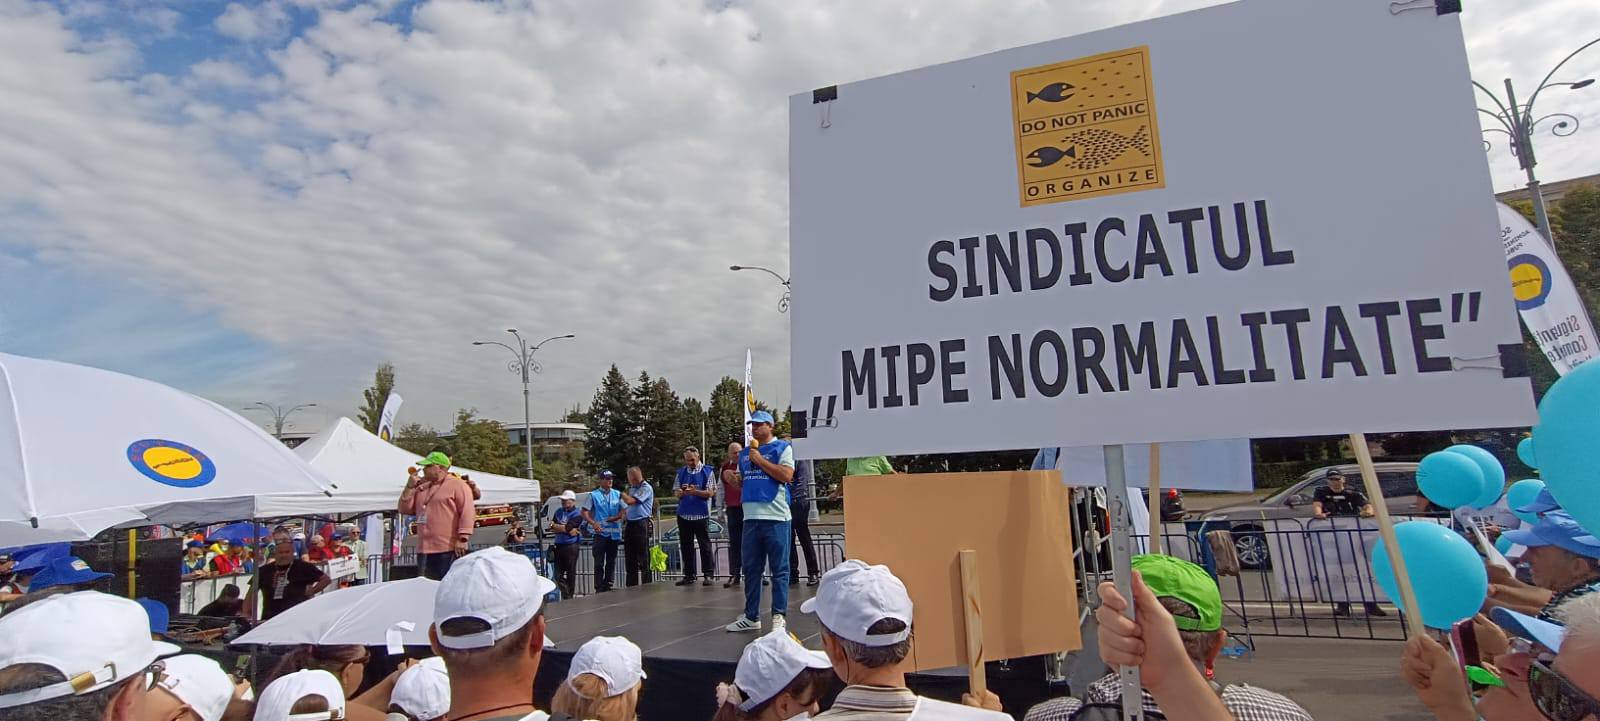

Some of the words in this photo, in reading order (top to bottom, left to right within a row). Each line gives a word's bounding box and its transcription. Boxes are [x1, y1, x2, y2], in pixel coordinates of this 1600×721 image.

[1021, 120, 1046, 133] DO
[1052, 113, 1088, 129] NOT
[1093, 103, 1146, 121] PANIC
[1027, 169, 1155, 197] ORGANIZE
[928, 200, 1295, 302] SINDICATUL
